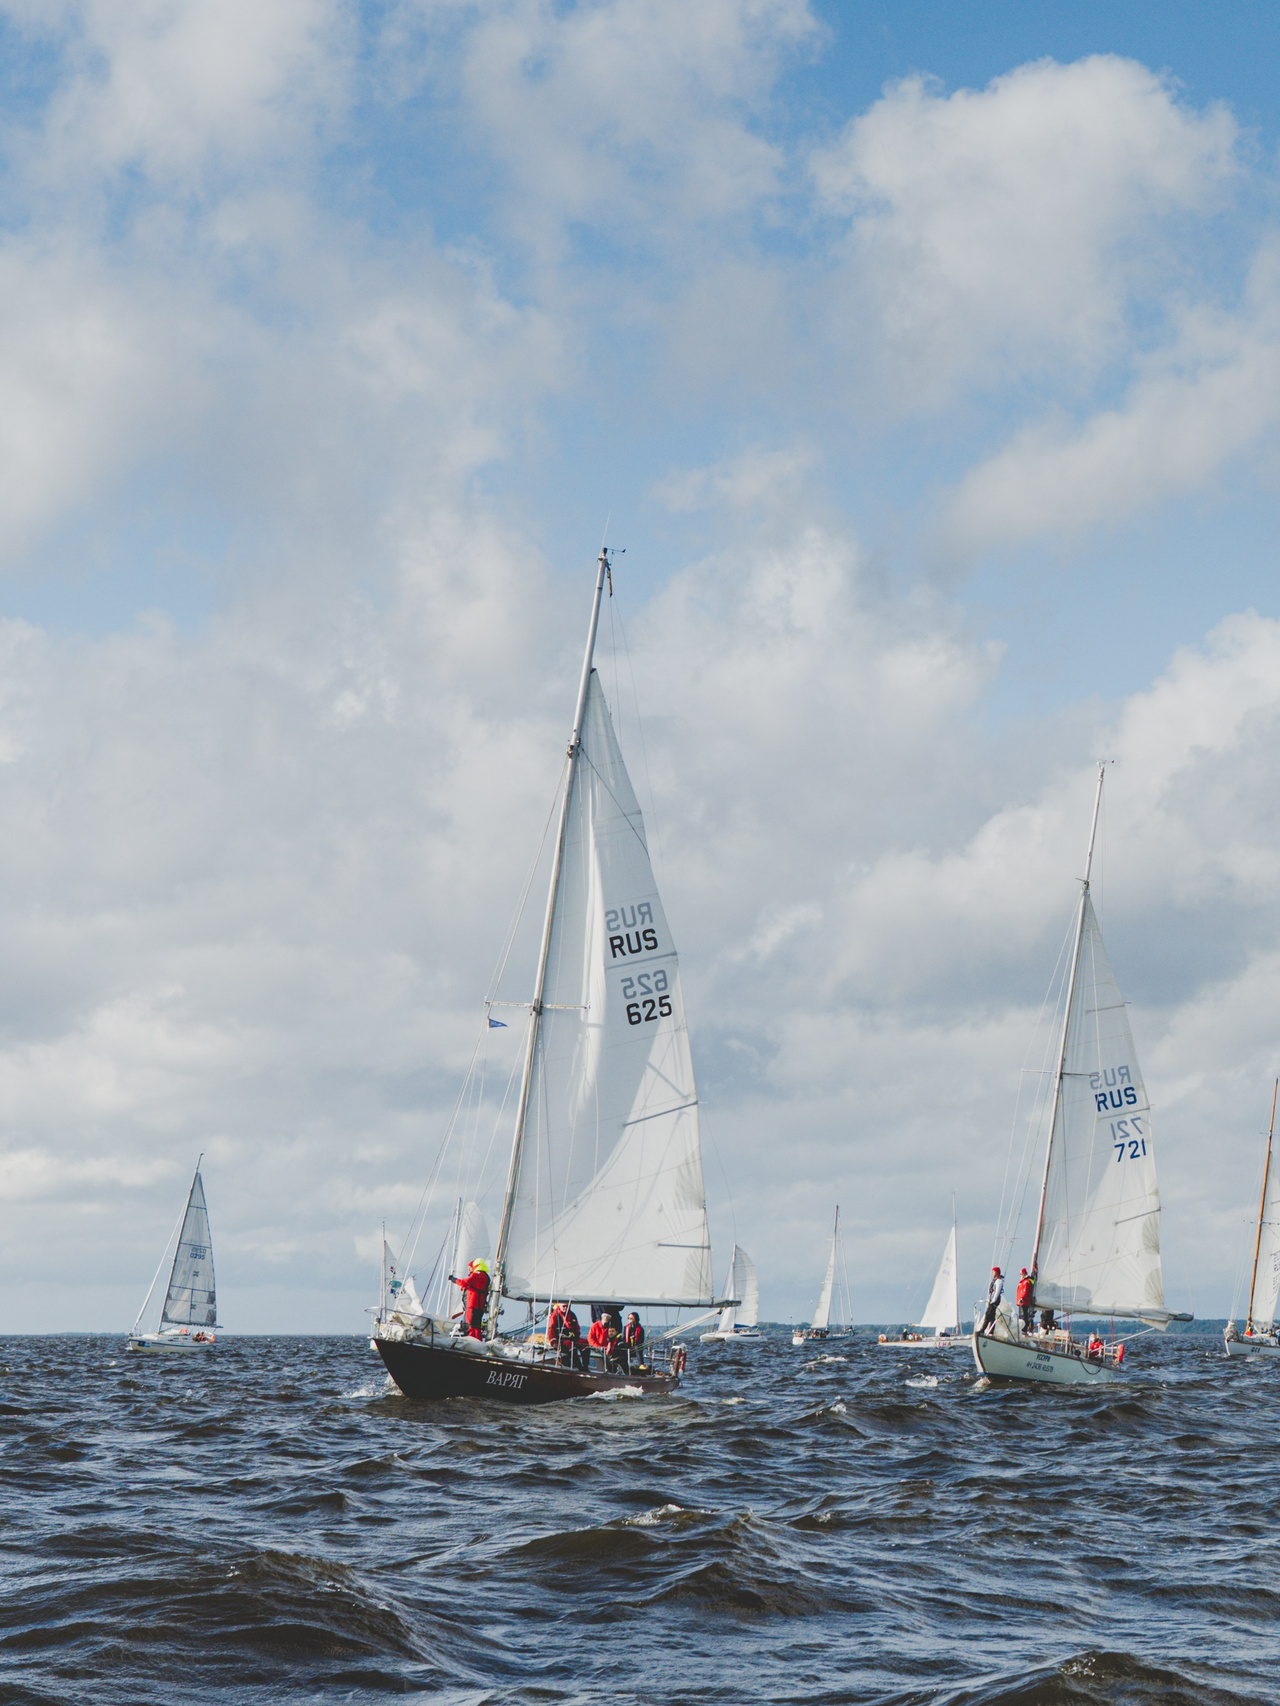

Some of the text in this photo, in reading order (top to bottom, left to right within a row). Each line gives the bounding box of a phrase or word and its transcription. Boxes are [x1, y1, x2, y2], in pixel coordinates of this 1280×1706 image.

[608, 927, 659, 959] RUS
[626, 994, 673, 1026] 625
[1094, 1086, 1138, 1112] RUS
[1114, 1138, 1147, 1163] 721
[486, 1370, 528, 1389] ВАРЯГ
